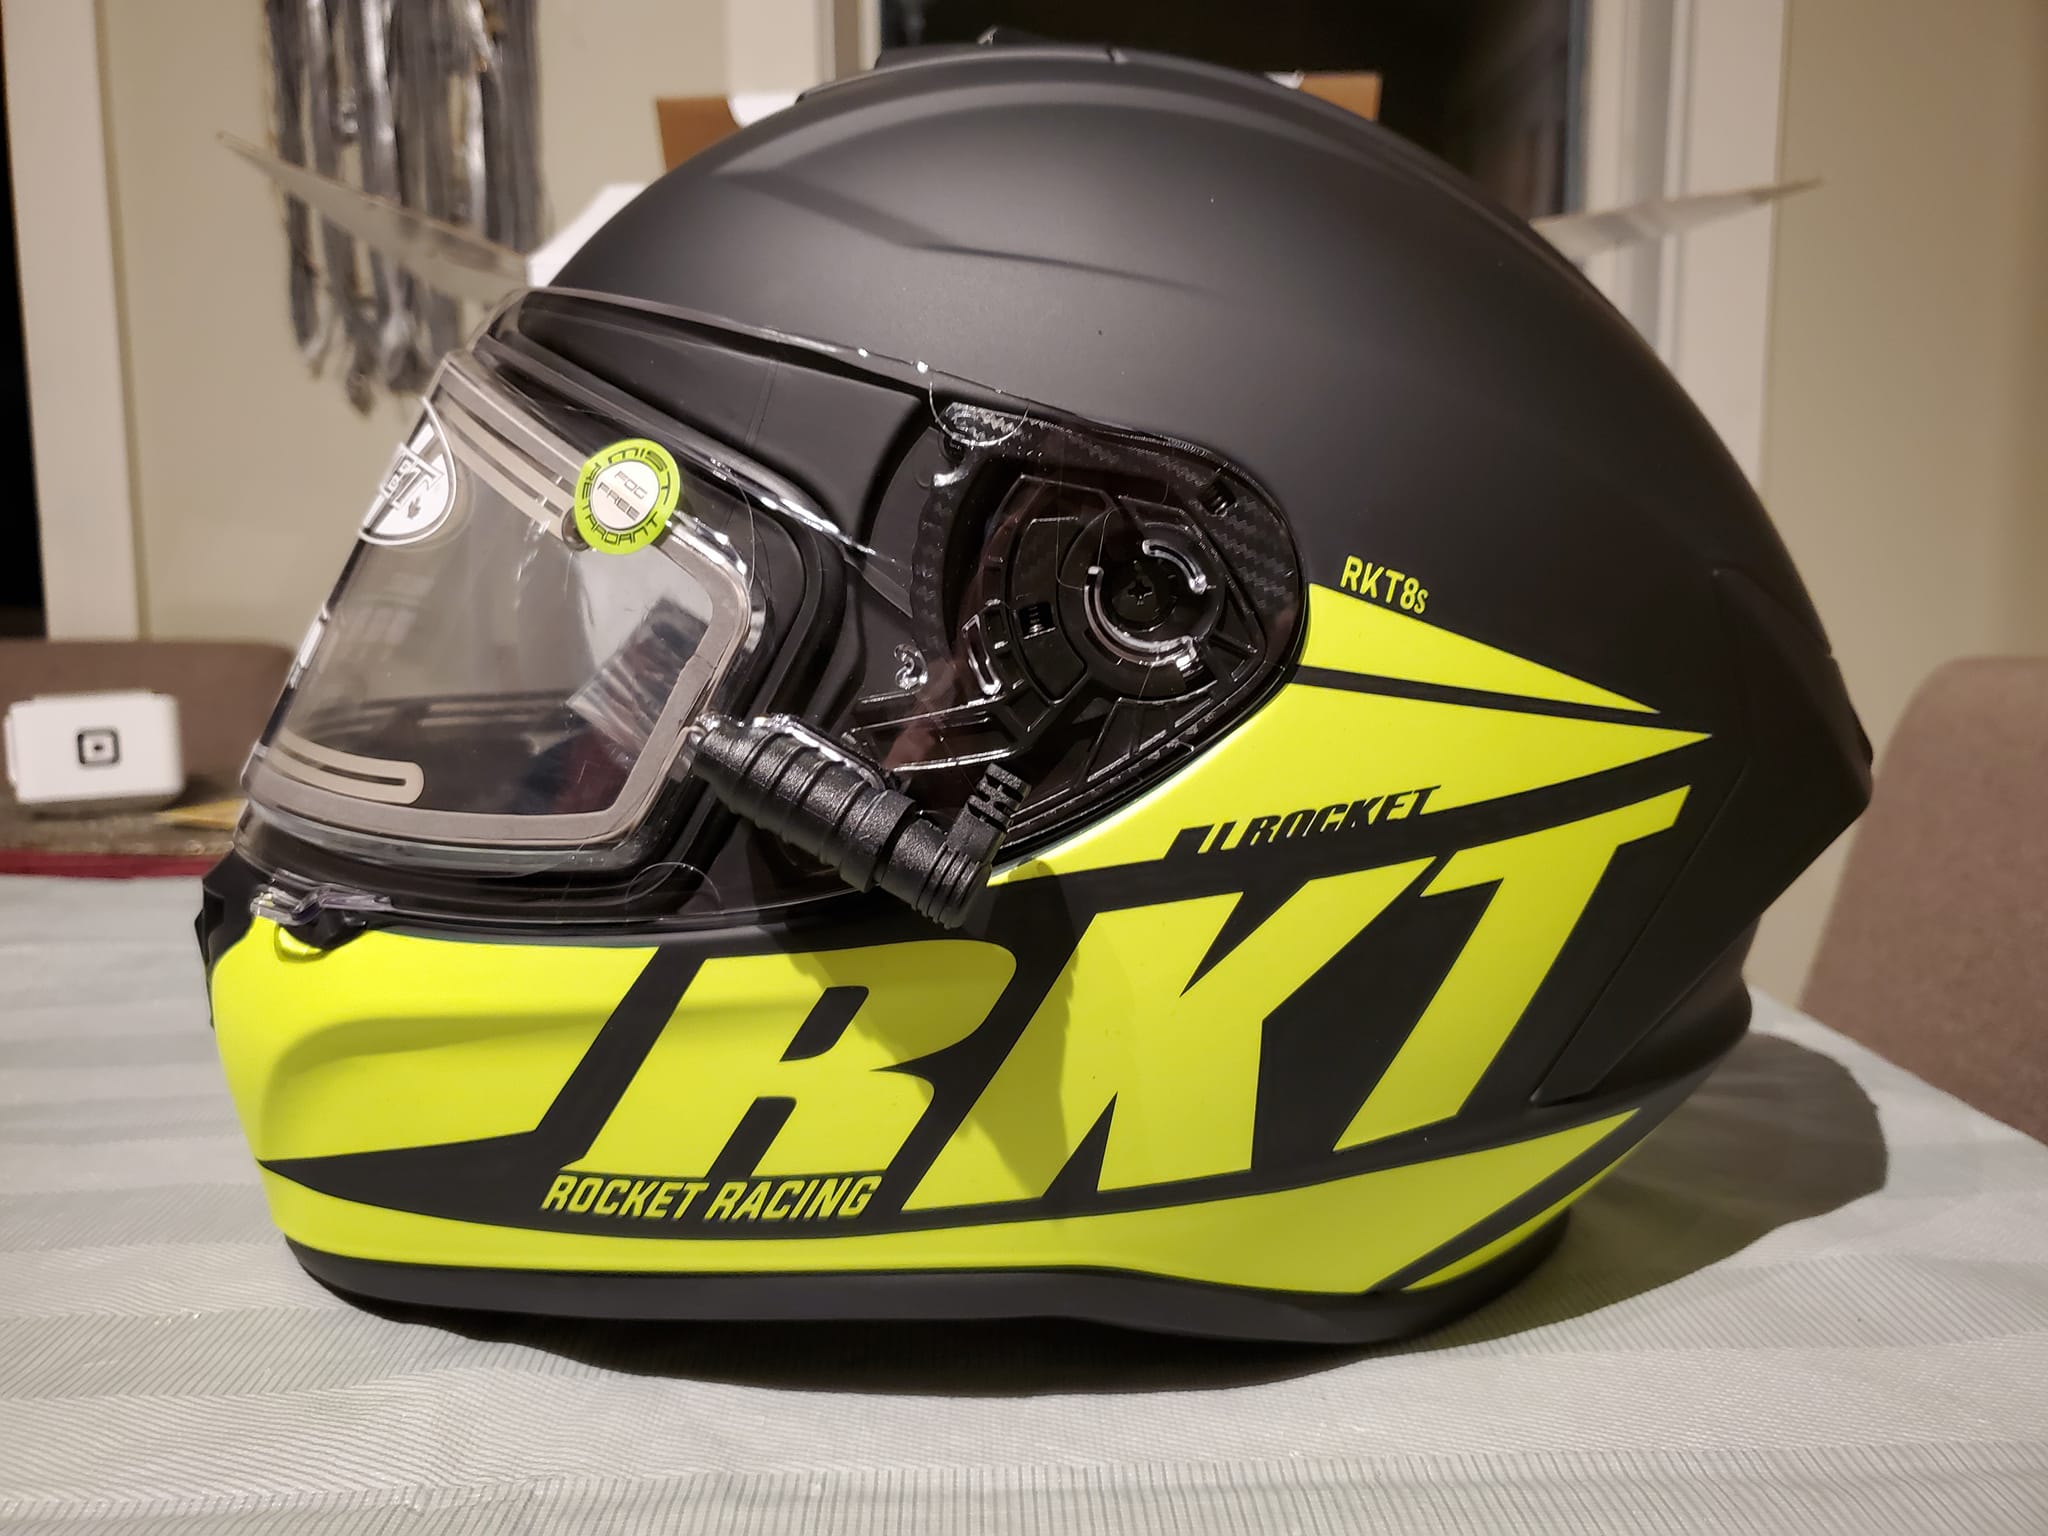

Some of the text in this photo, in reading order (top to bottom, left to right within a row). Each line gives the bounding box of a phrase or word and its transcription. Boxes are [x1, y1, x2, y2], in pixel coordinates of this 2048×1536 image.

[608, 447, 671, 506] MIST
[597, 481, 641, 522] FREE
[541, 1174, 882, 1221] ROCKET RACING
